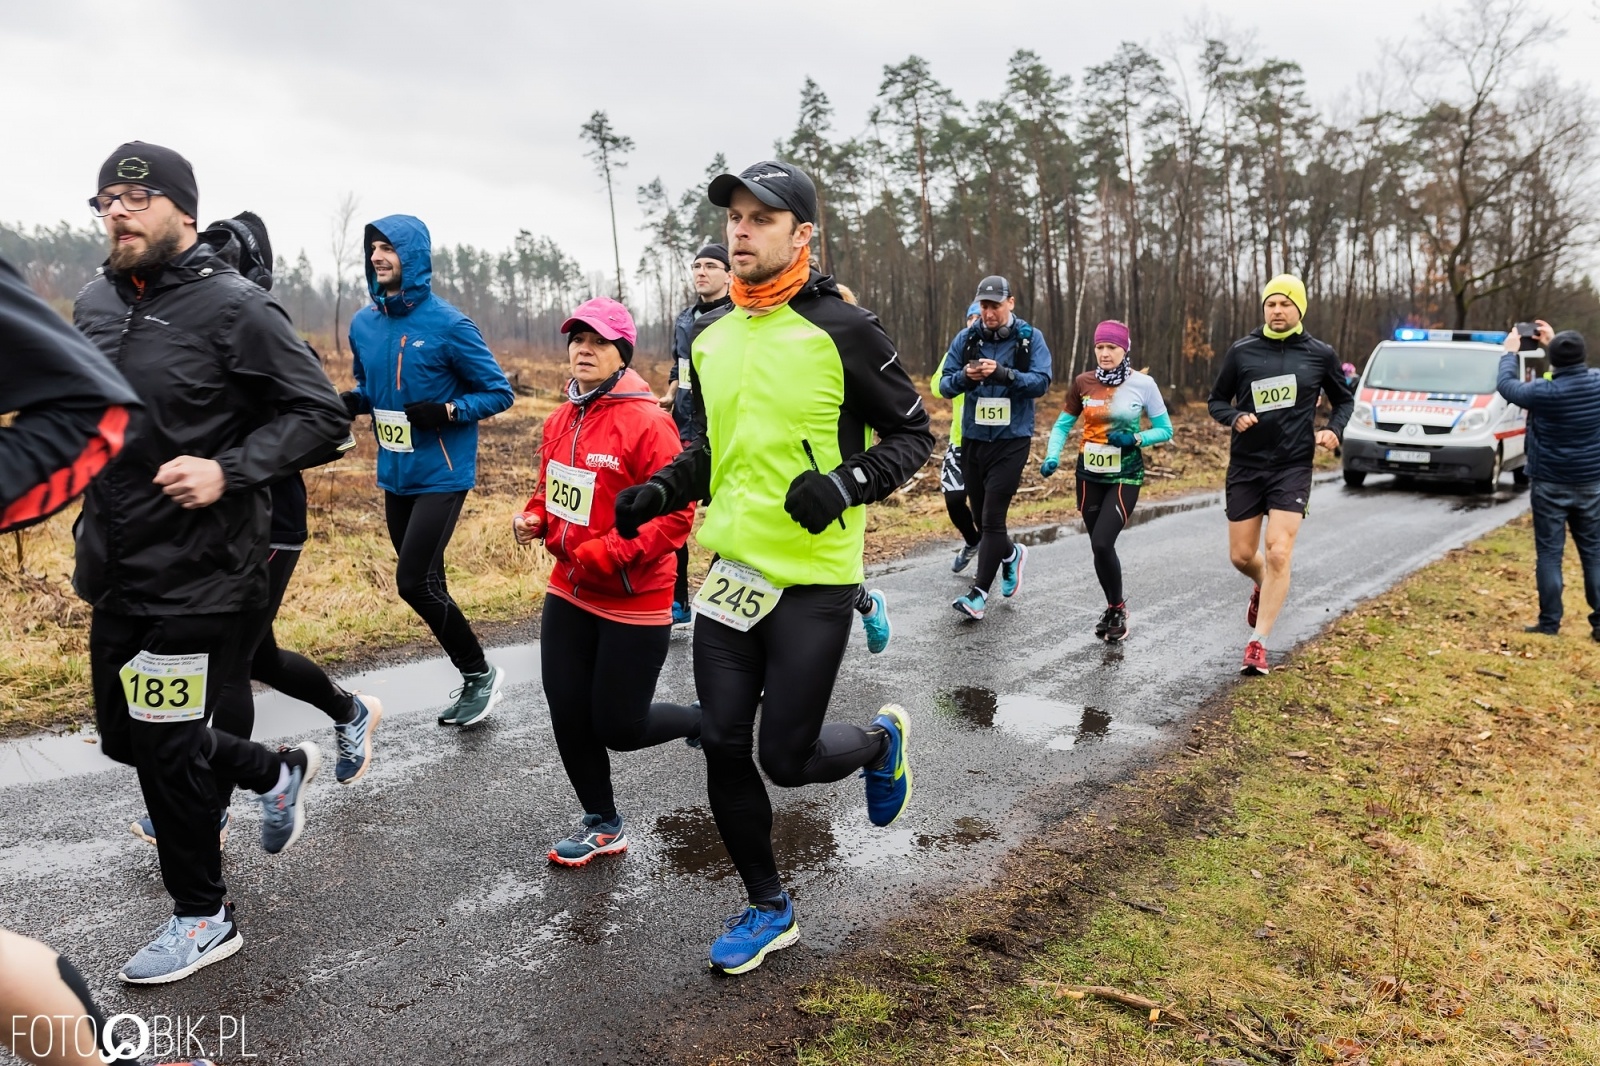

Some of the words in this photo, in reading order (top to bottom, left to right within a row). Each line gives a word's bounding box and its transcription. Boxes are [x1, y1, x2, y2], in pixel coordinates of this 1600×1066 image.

[1260, 386, 1291, 404] 202
[980, 407, 1003, 419] 151
[378, 423, 404, 444] 192
[586, 453, 620, 465] PITBULL
[1089, 453, 1113, 467] 201
[551, 479, 582, 511] 250
[707, 577, 765, 618] 245
[129, 673, 189, 707] 183
